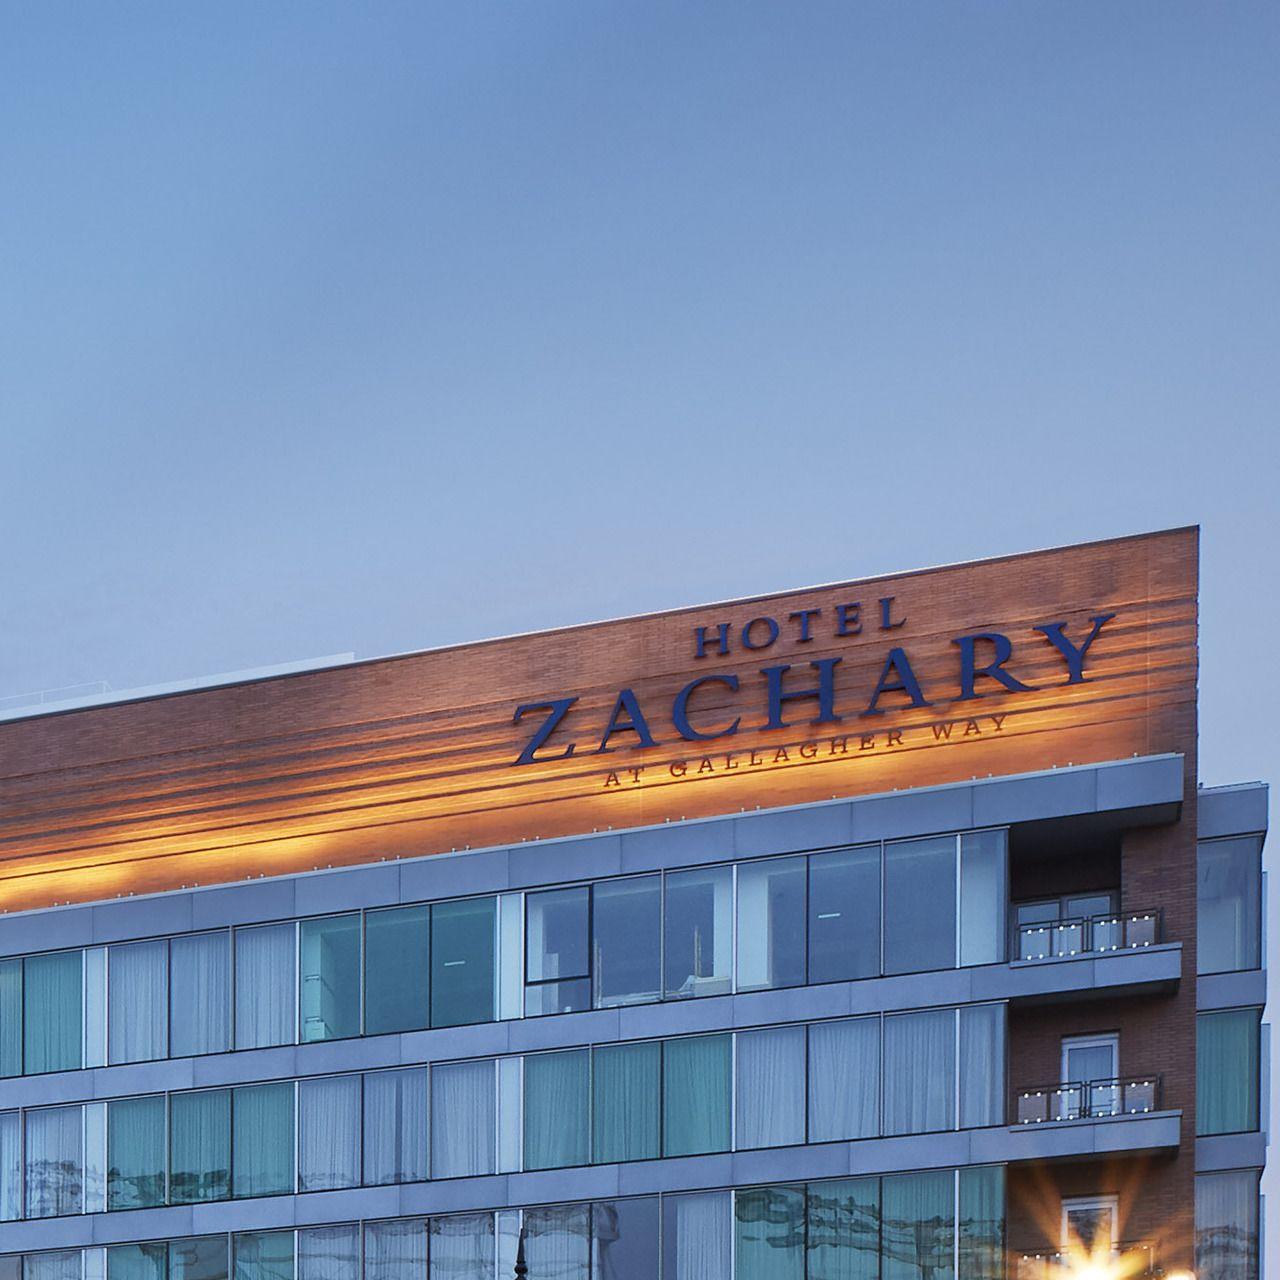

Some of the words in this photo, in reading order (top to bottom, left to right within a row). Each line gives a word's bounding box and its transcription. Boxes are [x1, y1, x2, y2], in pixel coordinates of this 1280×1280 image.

[694, 596, 907, 659] HOTEL
[510, 612, 1117, 768] ZACHARY
[603, 767, 645, 788] AT
[669, 729, 905, 778] GALLAGHER
[931, 713, 1009, 741] WAY
